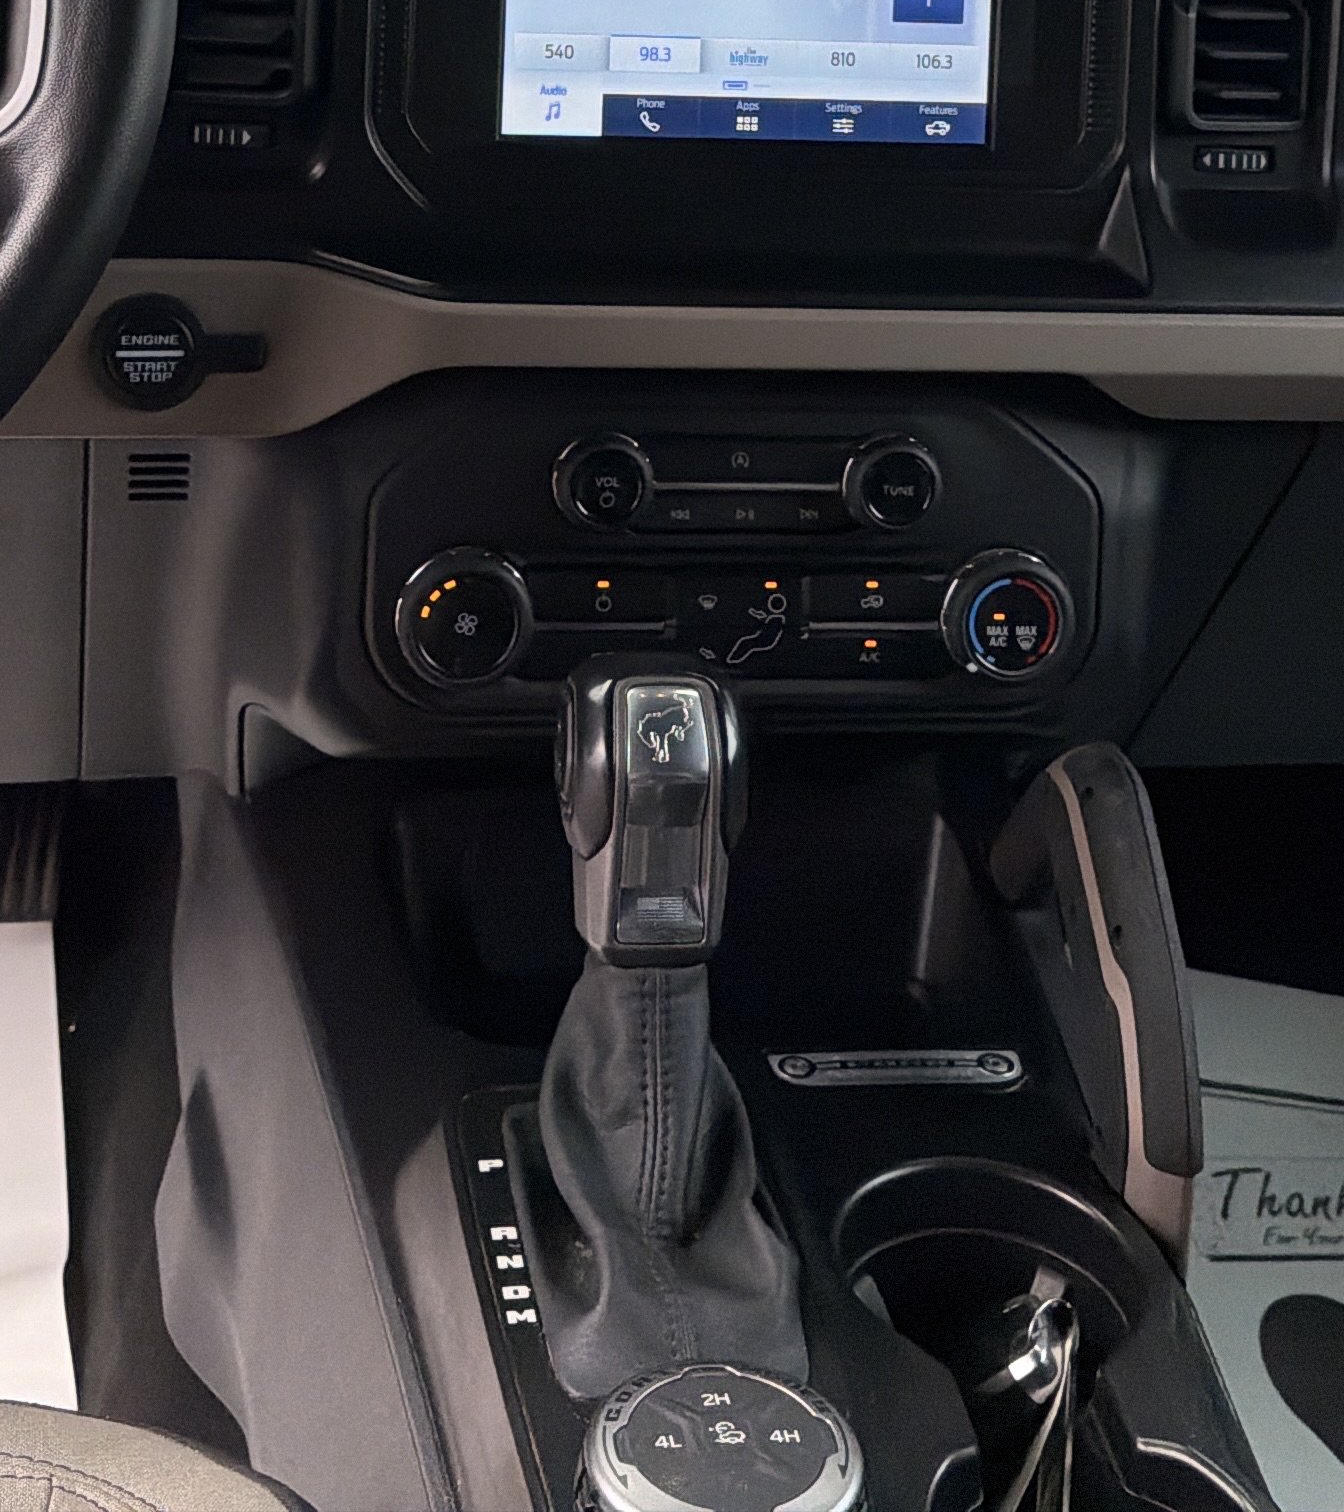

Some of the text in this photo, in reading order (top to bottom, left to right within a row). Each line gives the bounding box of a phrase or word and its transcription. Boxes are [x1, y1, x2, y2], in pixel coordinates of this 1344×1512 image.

[544, 44, 575, 61] 540
[639, 47, 672, 62] 98.3
[729, 49, 769, 67] highway
[830, 51, 857, 68] 810
[915, 53, 954, 70] 106.3
[539, 85, 567, 97] Audio
[636, 98, 666, 110] Phone
[736, 100, 760, 113] Apps
[825, 102, 863, 115] Settings
[919, 104, 959, 116] Features
[121, 334, 179, 346] ENGINE
[123, 361, 178, 372] START
[129, 372, 173, 383] STOP
[595, 477, 620, 488] VOL
[883, 485, 914, 496] TUNE
[986, 625, 1009, 636] MAX
[1015, 625, 1038, 636] MAX
[989, 636, 1008, 647] A/C
[477, 1158, 504, 1173] P
[490, 1225, 518, 1240] R
[496, 1254, 524, 1269] N
[502, 1285, 531, 1300] D
[506, 1308, 536, 1324] M
[700, 1392, 731, 1407] 2H
[654, 1434, 683, 1449] 4L
[769, 1429, 801, 1444] 4H
